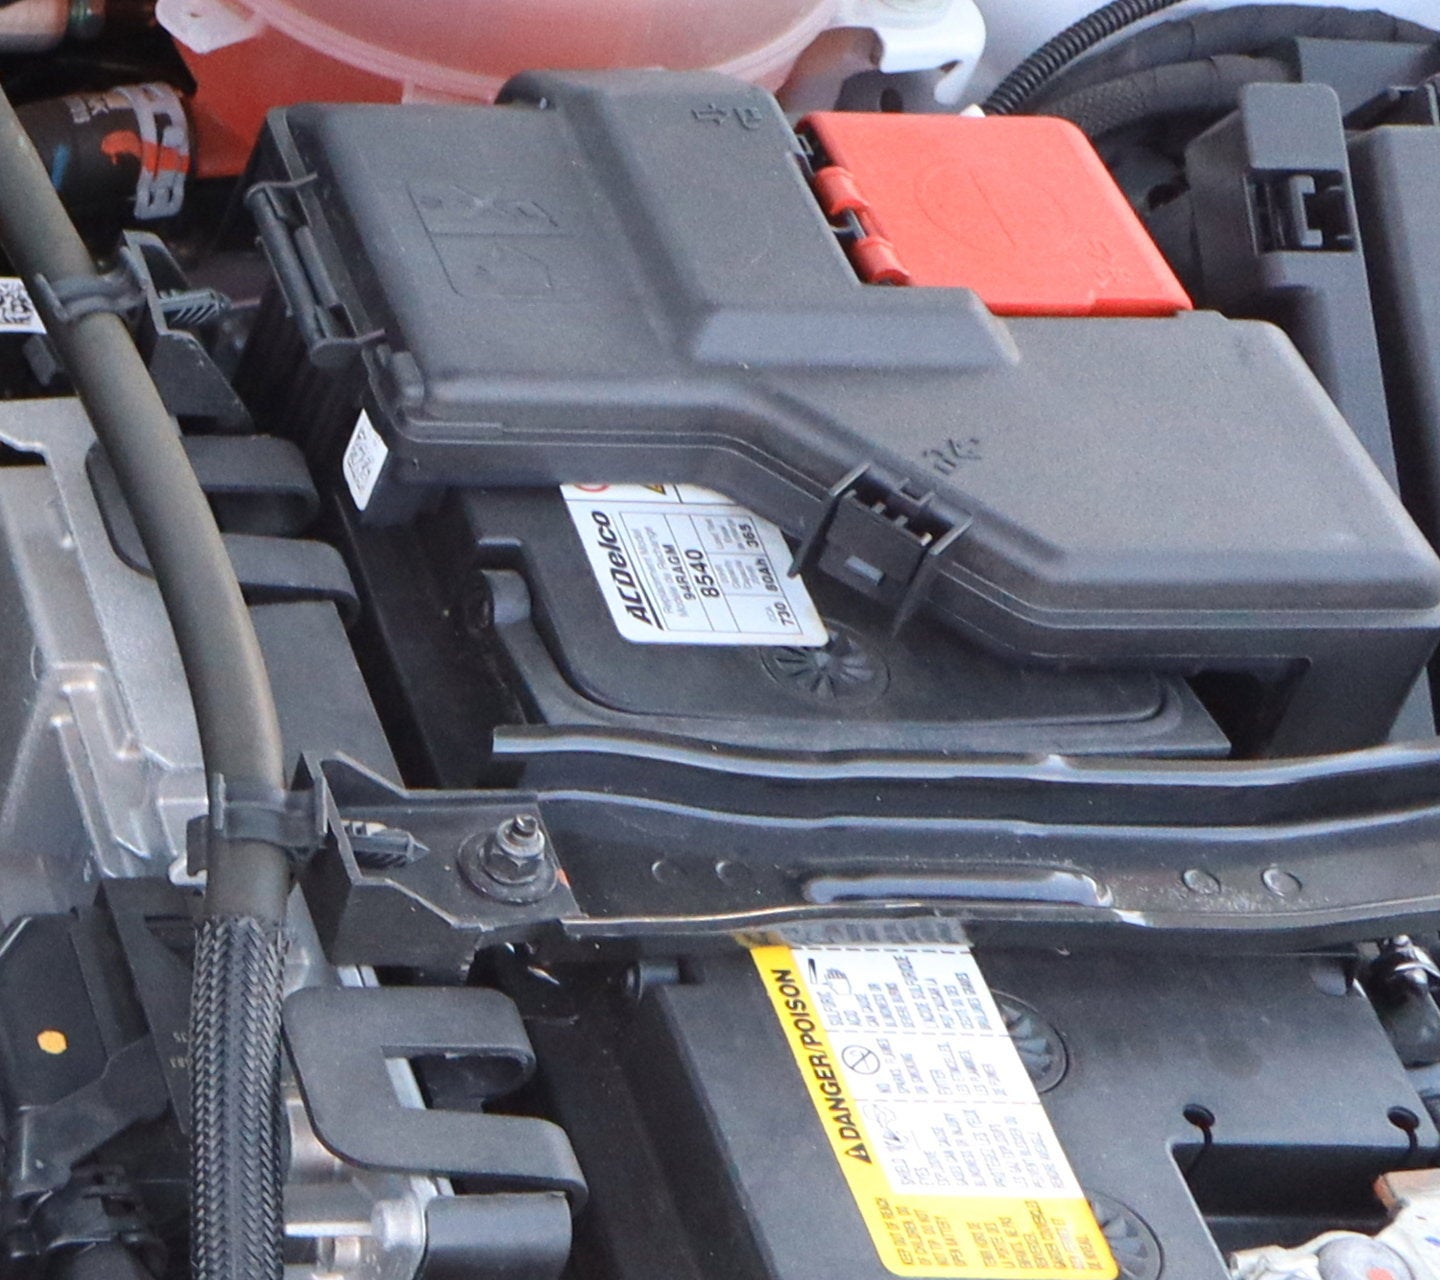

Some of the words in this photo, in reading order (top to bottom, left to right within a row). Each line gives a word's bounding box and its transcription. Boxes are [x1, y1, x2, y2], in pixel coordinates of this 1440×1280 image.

[739, 524, 760, 547] 365
[592, 511, 653, 624] ACDelco
[662, 545, 697, 600] 94RAGM
[684, 549, 721, 597] 8540
[755, 559, 778, 591] 80Ah
[774, 602, 794, 625] 730
[770, 968, 862, 1141] DANGER/POISON
